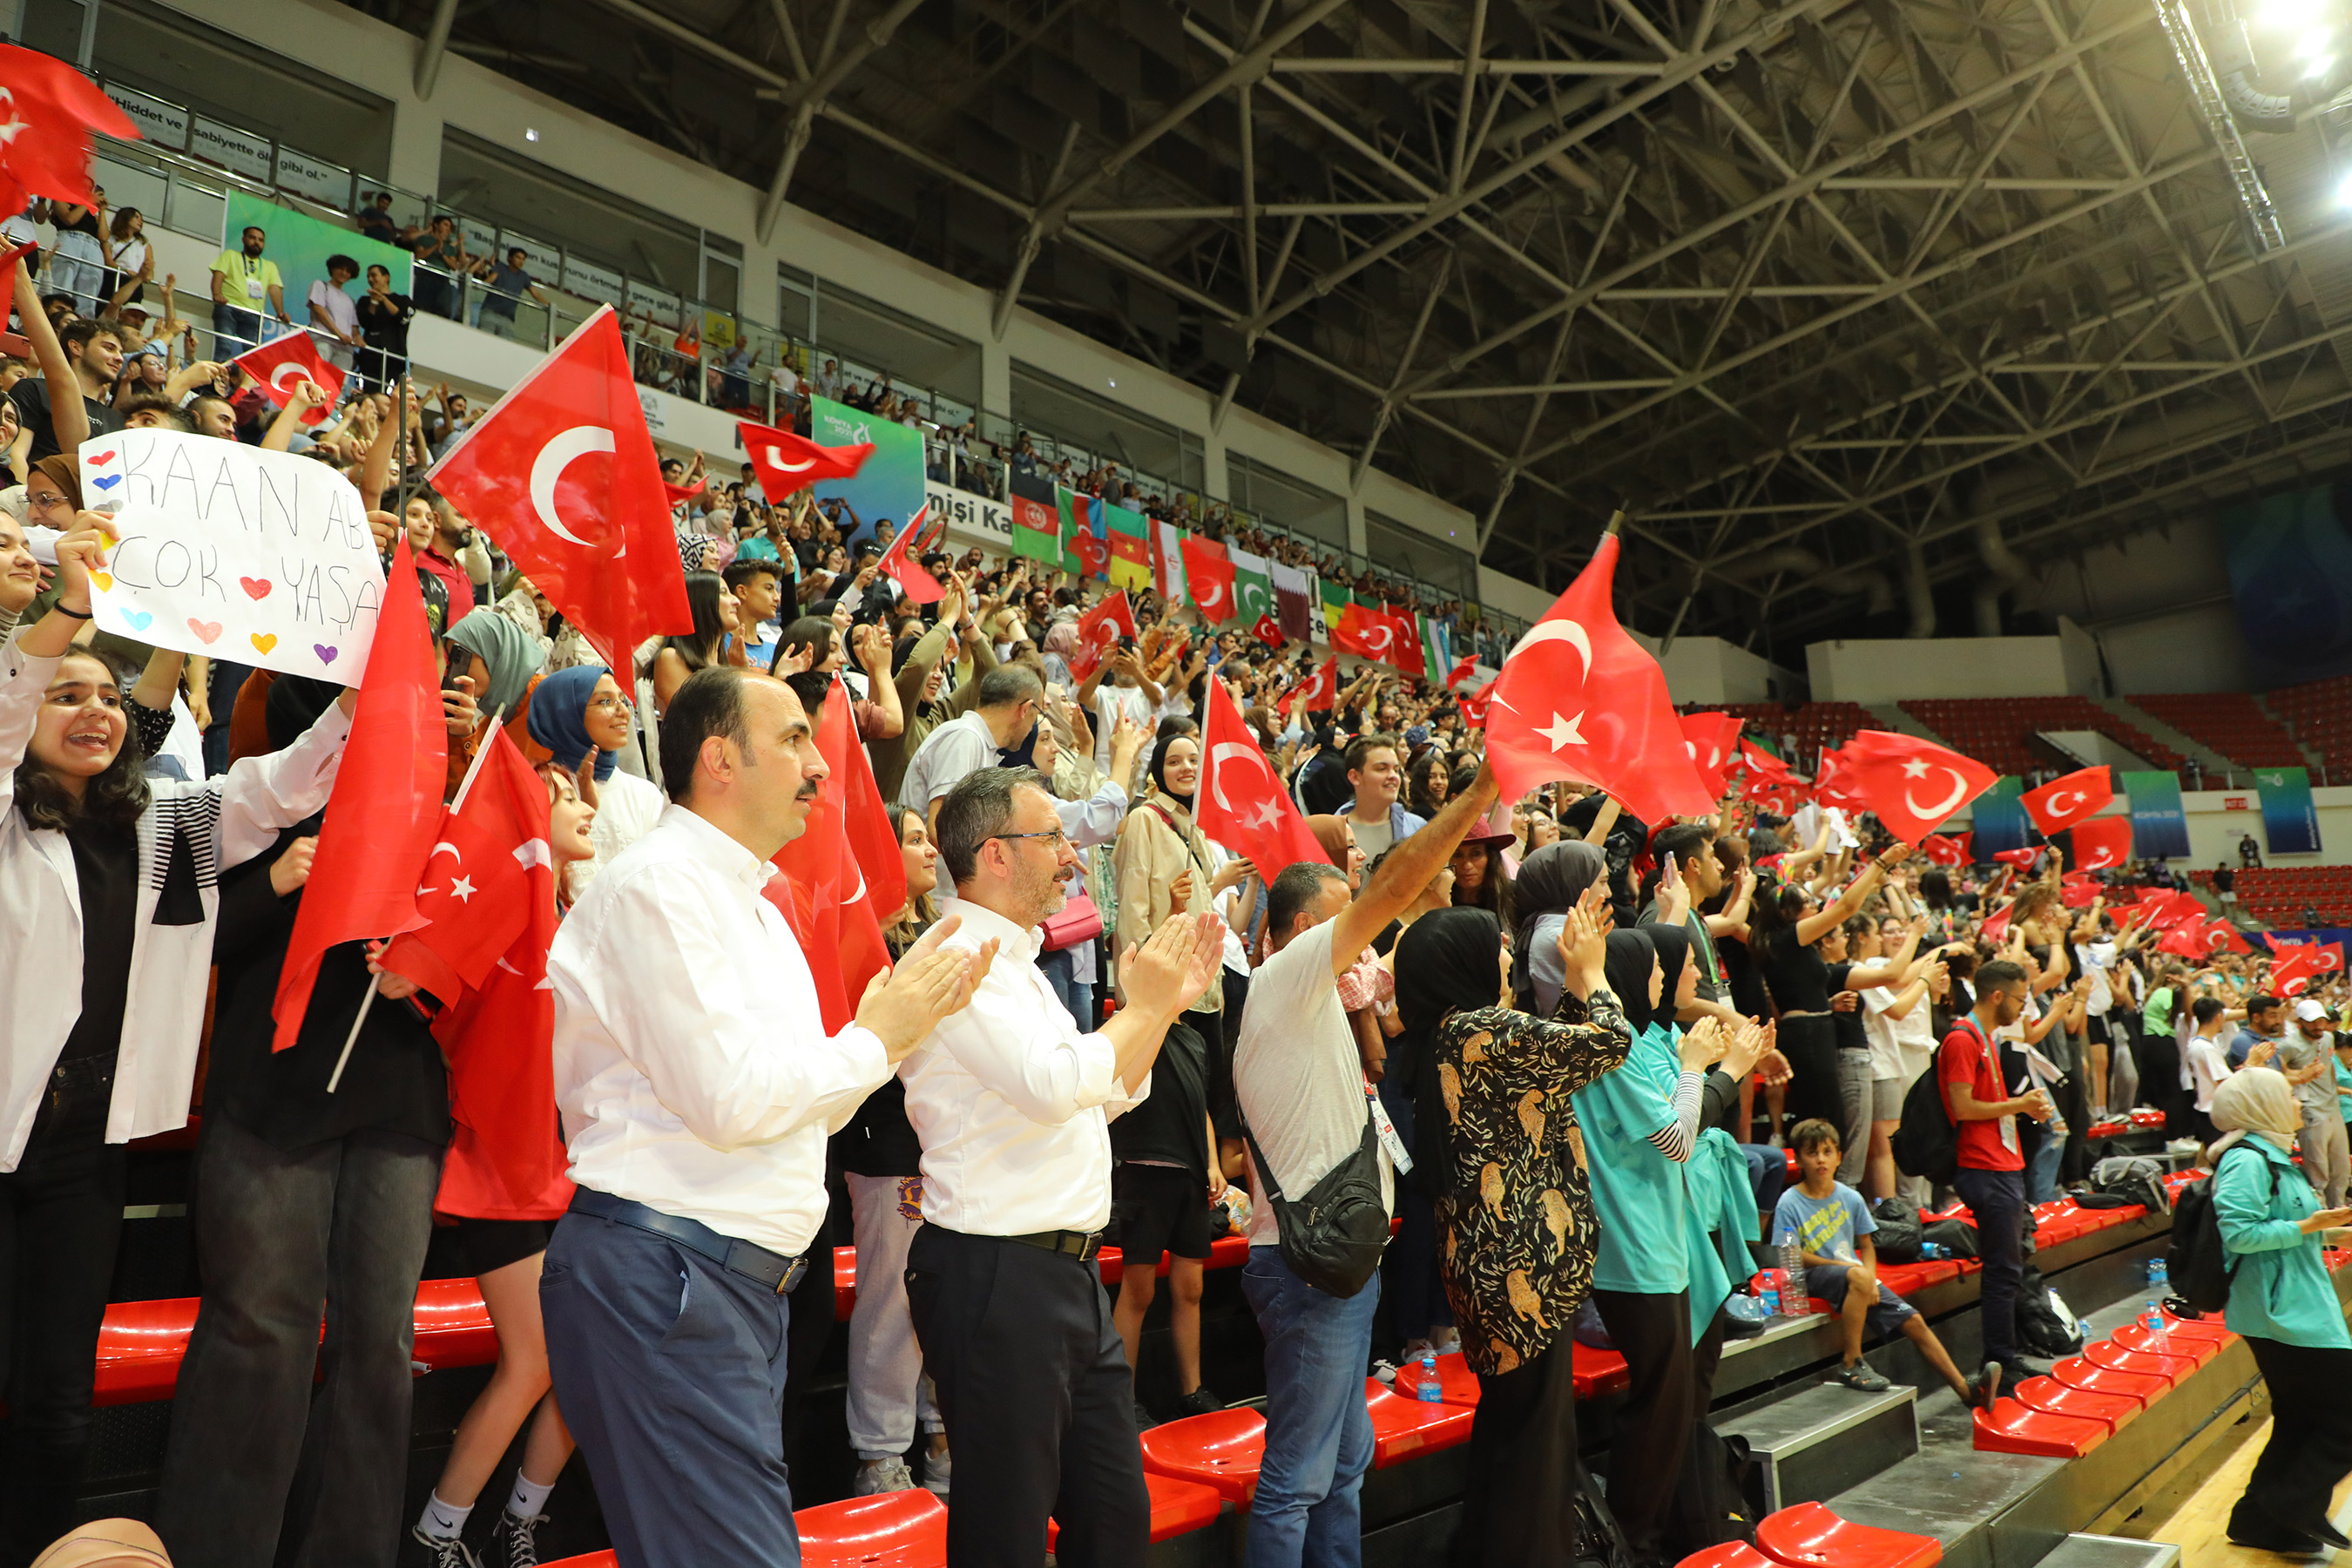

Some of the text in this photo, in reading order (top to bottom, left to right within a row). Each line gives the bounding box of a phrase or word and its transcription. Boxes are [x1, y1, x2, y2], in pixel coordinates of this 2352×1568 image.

[166, 115, 182, 130] ve
[186, 126, 253, 156] sabiyette
[280, 160, 303, 175] gibi
[824, 414, 852, 430] KONYA
[834, 424, 853, 436] 2021
[121, 437, 372, 553] KAAN AB
[983, 504, 1012, 536] Ka
[112, 536, 380, 636] ÇOK YAŞA
